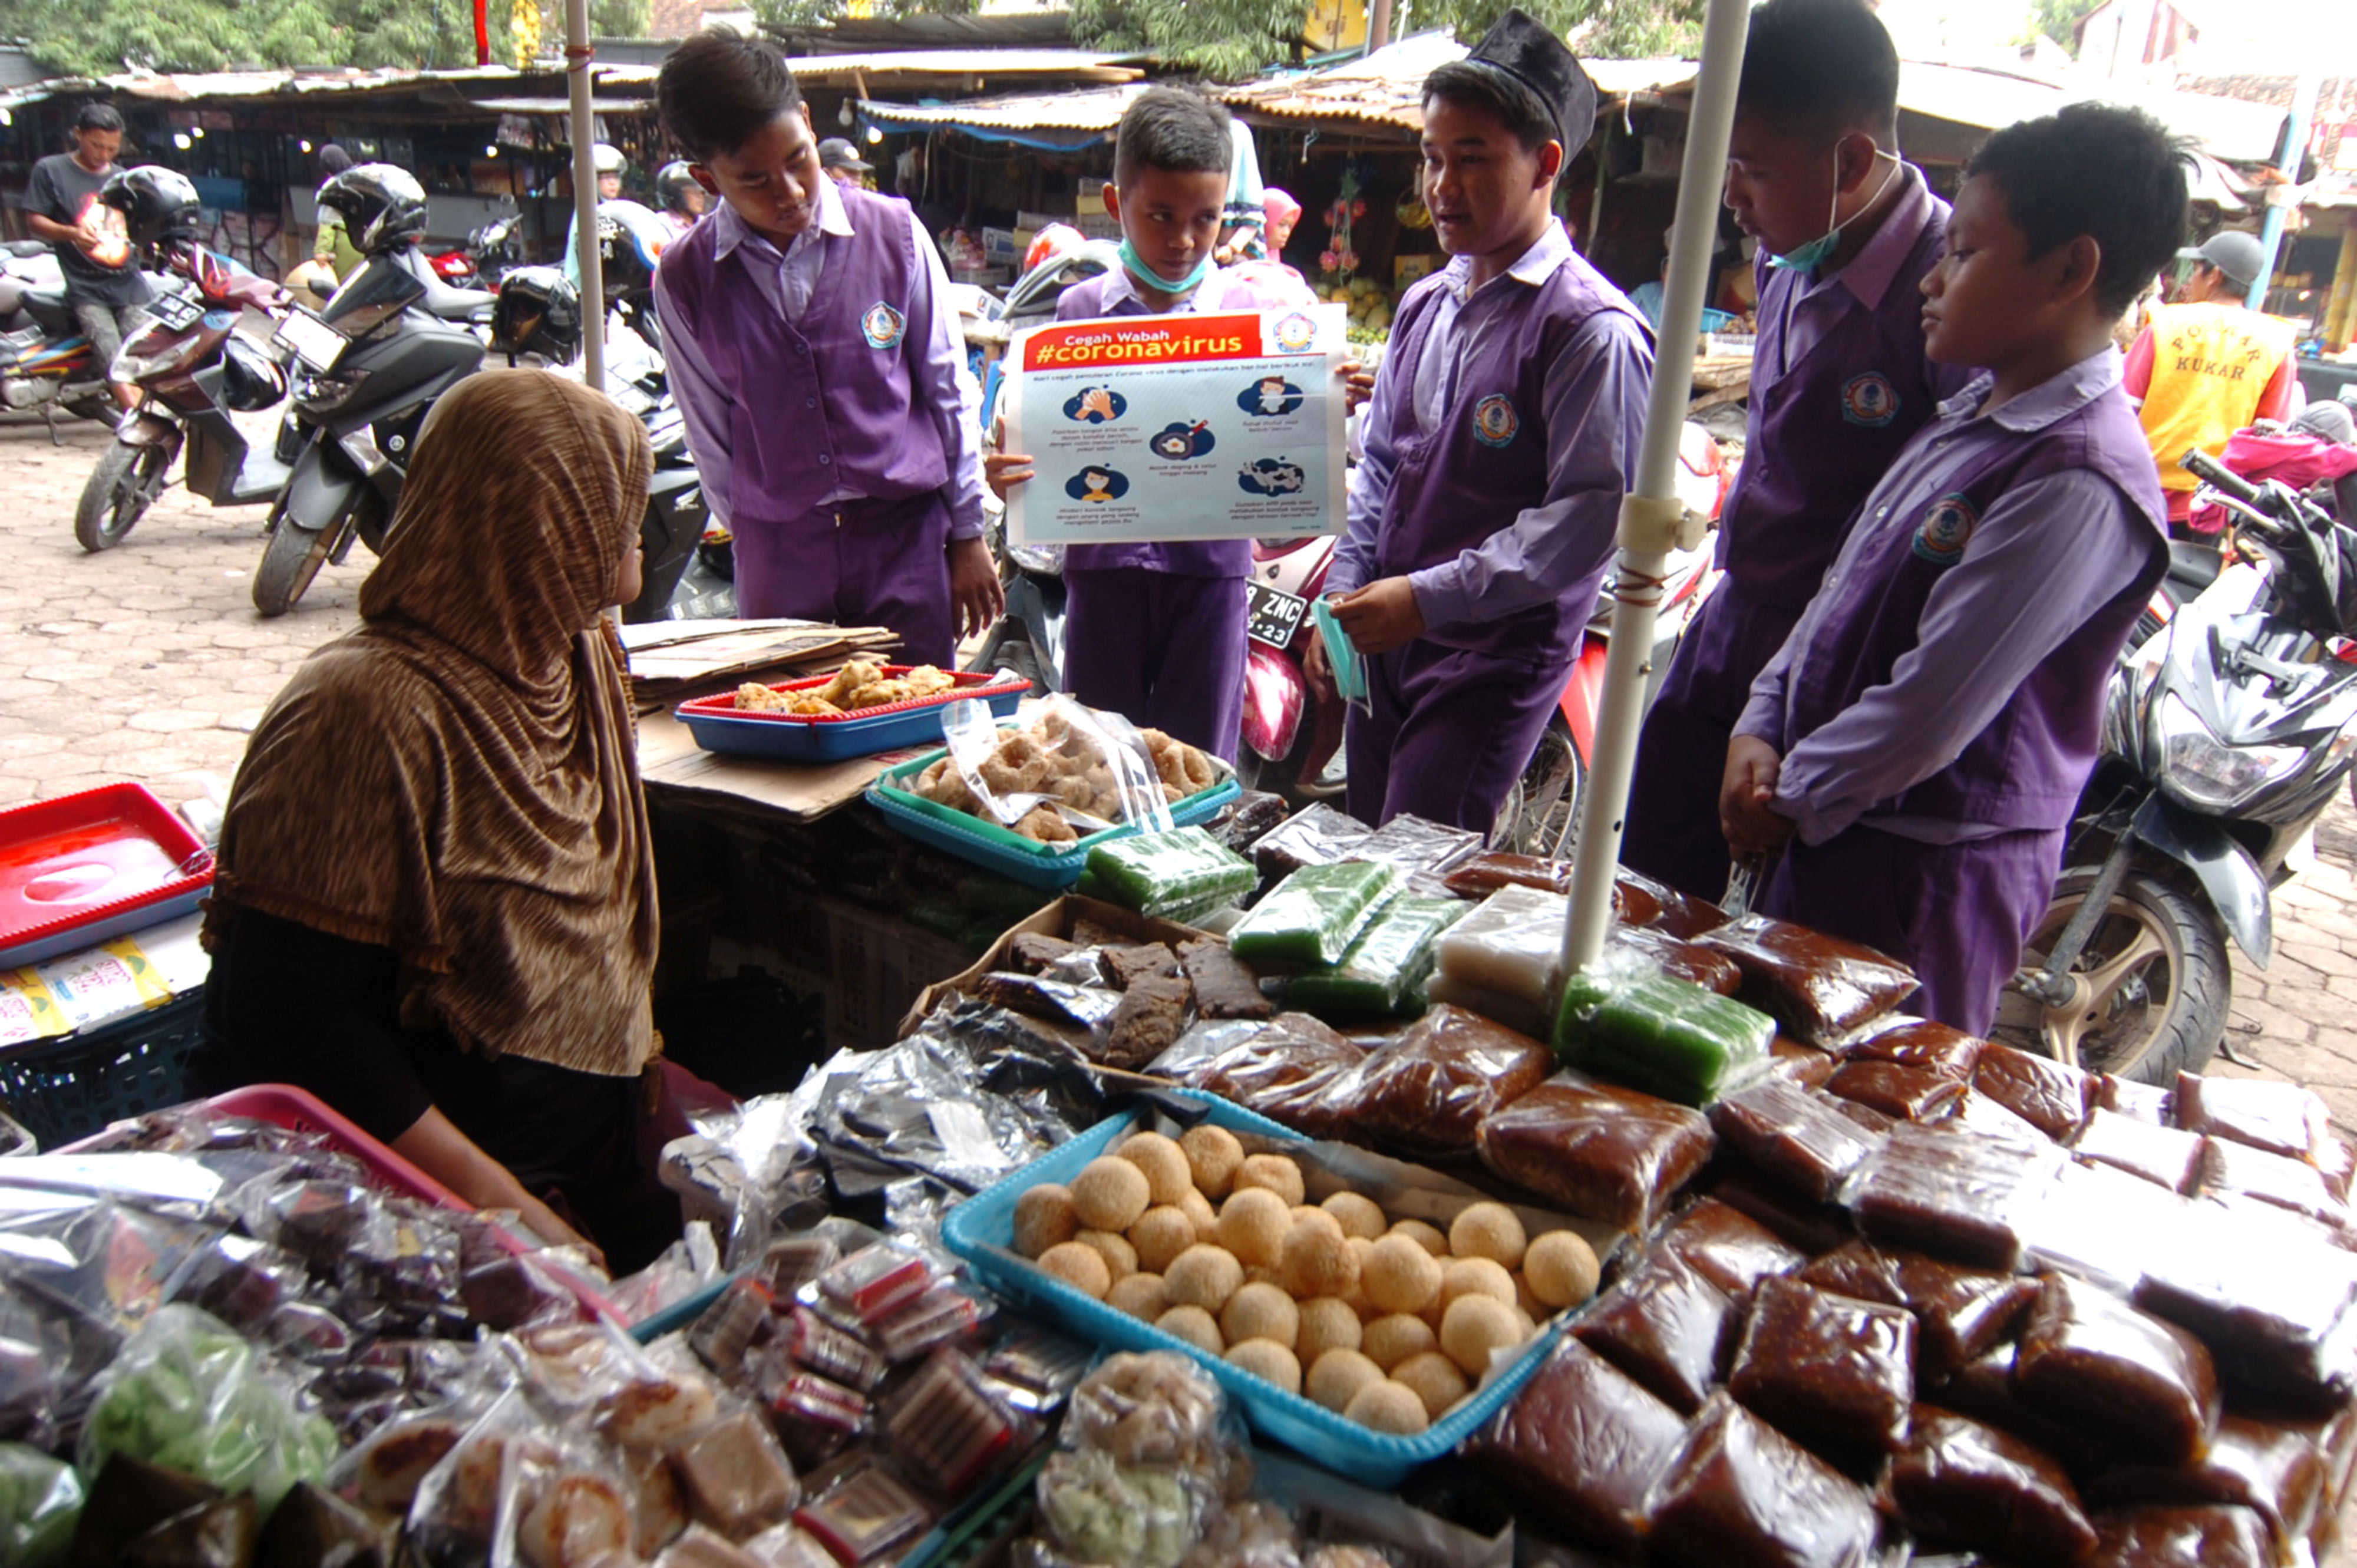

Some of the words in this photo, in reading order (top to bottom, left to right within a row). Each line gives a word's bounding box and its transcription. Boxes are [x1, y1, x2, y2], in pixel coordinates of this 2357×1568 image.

[1036, 335, 1242, 364] #coronavirus
[1065, 334, 1112, 346] Cegah
[1117, 330, 1170, 342] Wabah
[2176, 356, 2244, 380] KUKAR
[1262, 592, 1301, 622] ZNC
